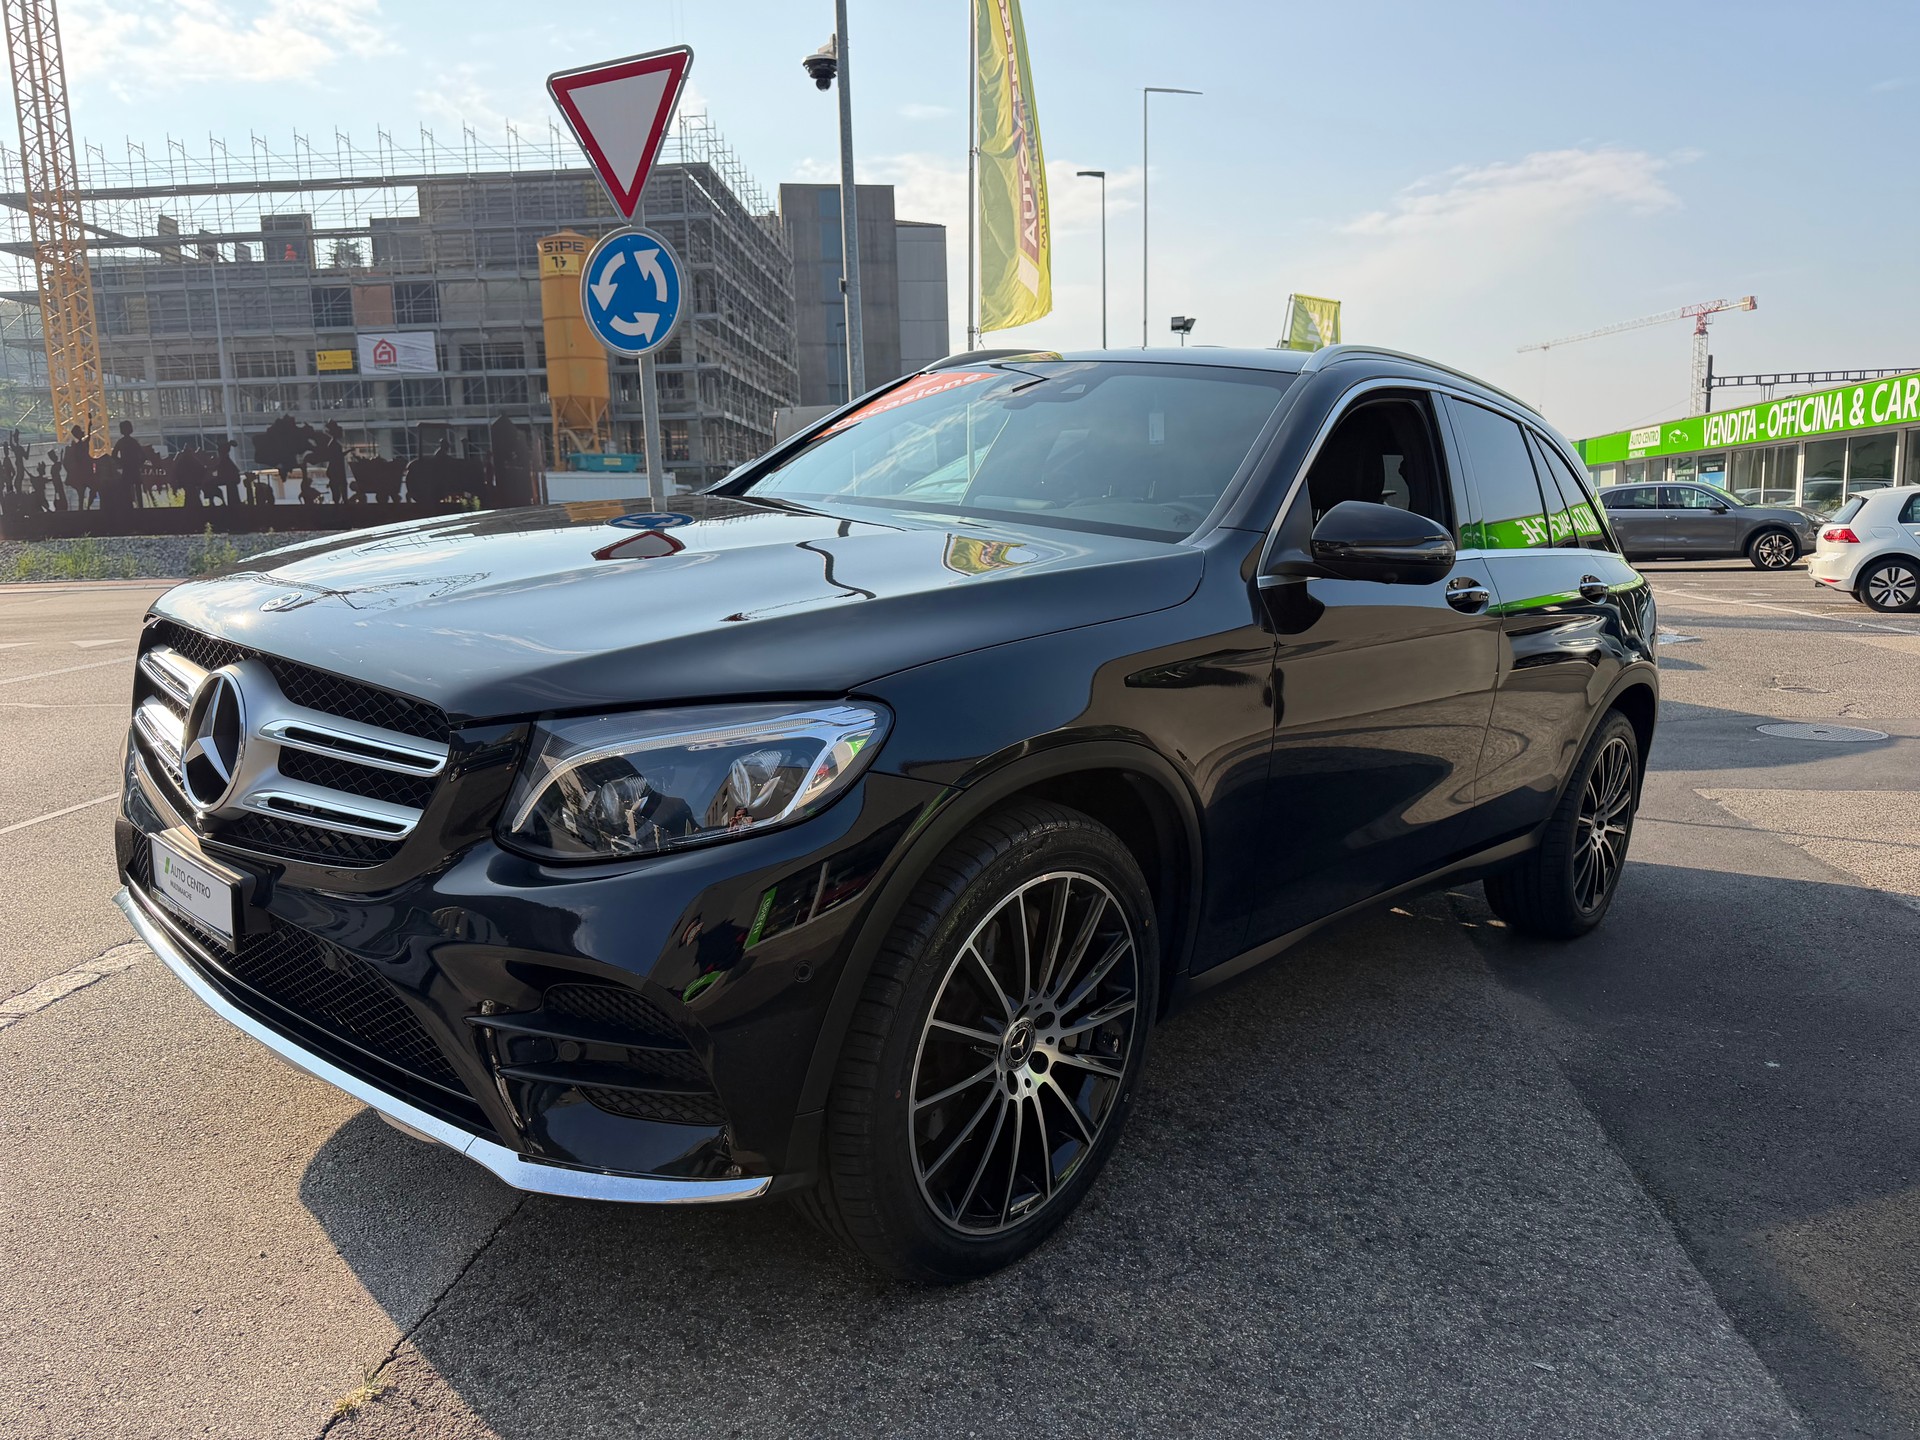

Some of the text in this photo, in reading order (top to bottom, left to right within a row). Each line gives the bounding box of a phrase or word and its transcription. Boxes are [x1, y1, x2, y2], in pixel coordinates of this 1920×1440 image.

[1020, 142, 1038, 248] AUTO
[1631, 430, 1659, 446] AUTO CENTRO
[1703, 409, 1757, 447] VENDITA
[1767, 392, 1844, 438] OFFICINA
[1850, 387, 1865, 427] &
[1871, 377, 1920, 424] CAR
[171, 864, 211, 899] AUTO CENTRO
